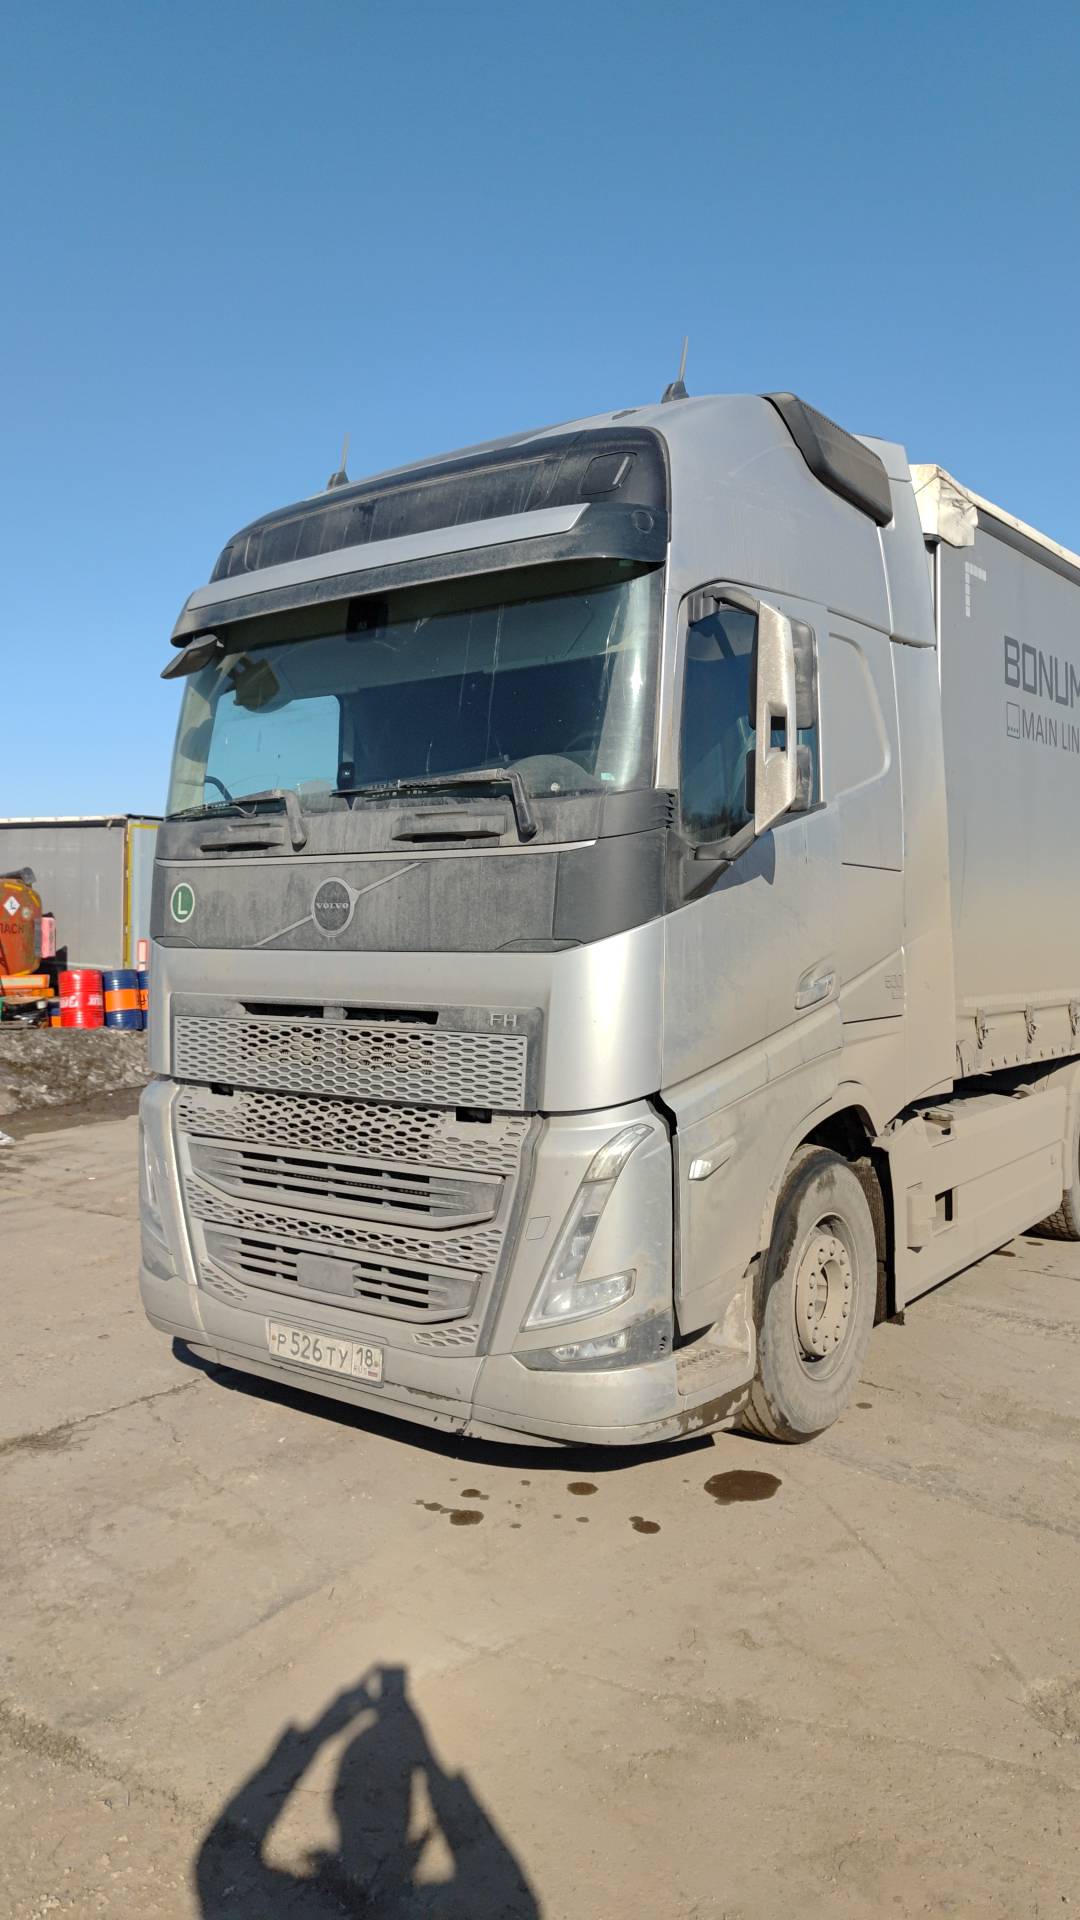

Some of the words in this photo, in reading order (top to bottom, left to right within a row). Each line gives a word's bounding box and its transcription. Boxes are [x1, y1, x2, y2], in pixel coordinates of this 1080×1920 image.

[1004, 635, 1080, 708] BONUM
[1022, 709, 1058, 747] MAIN
[177, 891, 188, 915] L
[490, 1013, 517, 1027] FH
